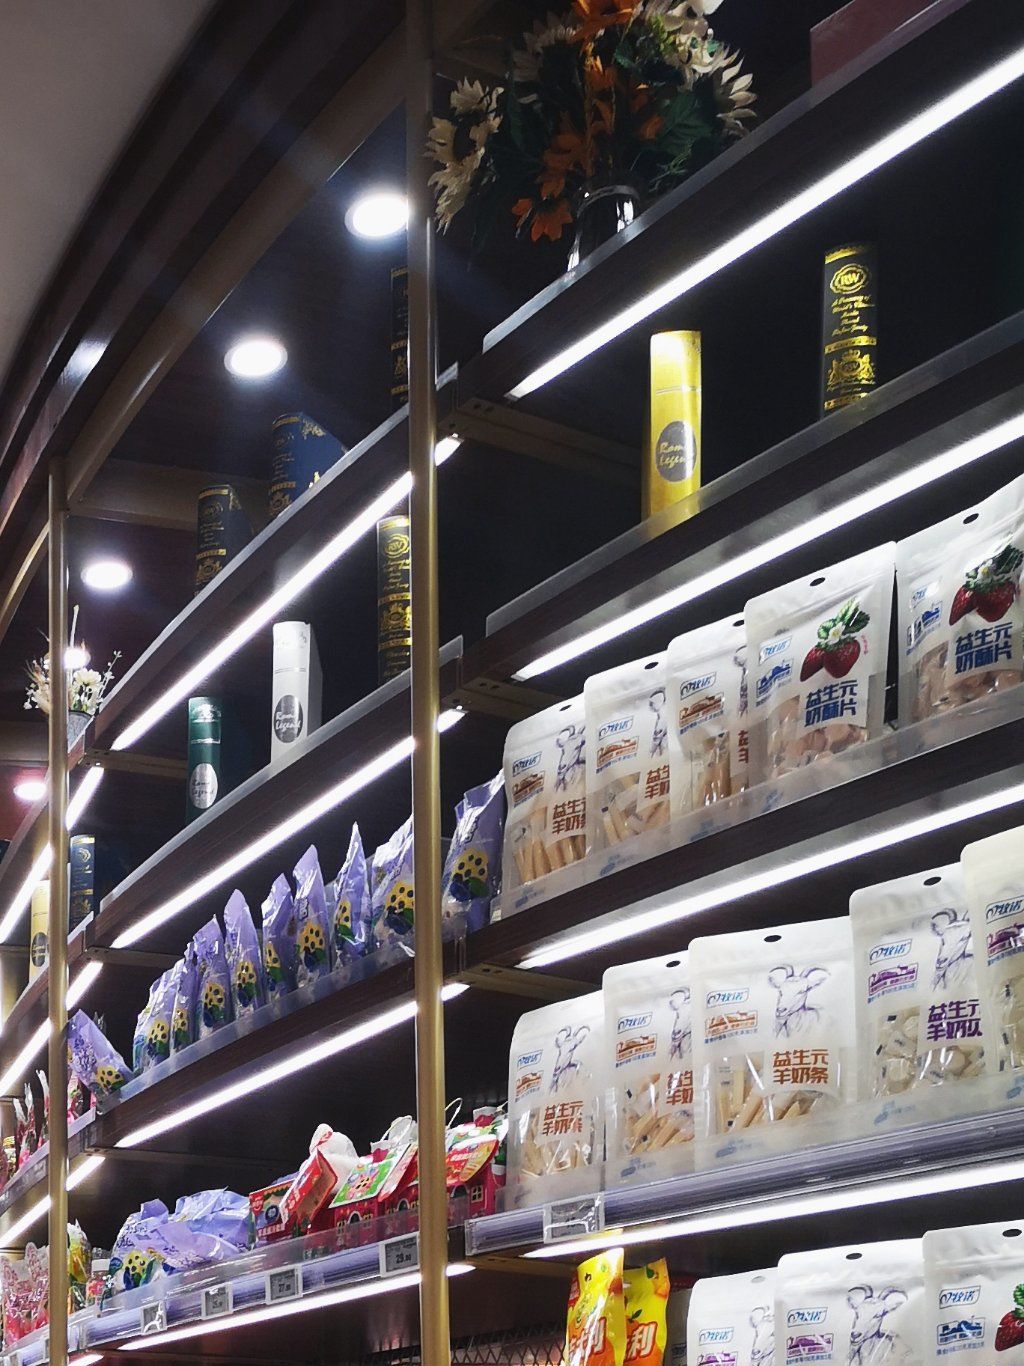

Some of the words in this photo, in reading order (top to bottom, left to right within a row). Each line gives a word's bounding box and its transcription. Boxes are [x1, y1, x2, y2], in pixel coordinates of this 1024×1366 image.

[956, 622, 1013, 651] 益生元
[955, 644, 1013, 675] 奶酥片
[806, 679, 858, 710] 益生元
[804, 701, 857, 727] 奶酥片
[773, 1048, 829, 1067] 益生元
[773, 1066, 829, 1085] 羊奶条
[544, 1100, 583, 1119] 益生元
[542, 1117, 583, 1136] 羊奶条
